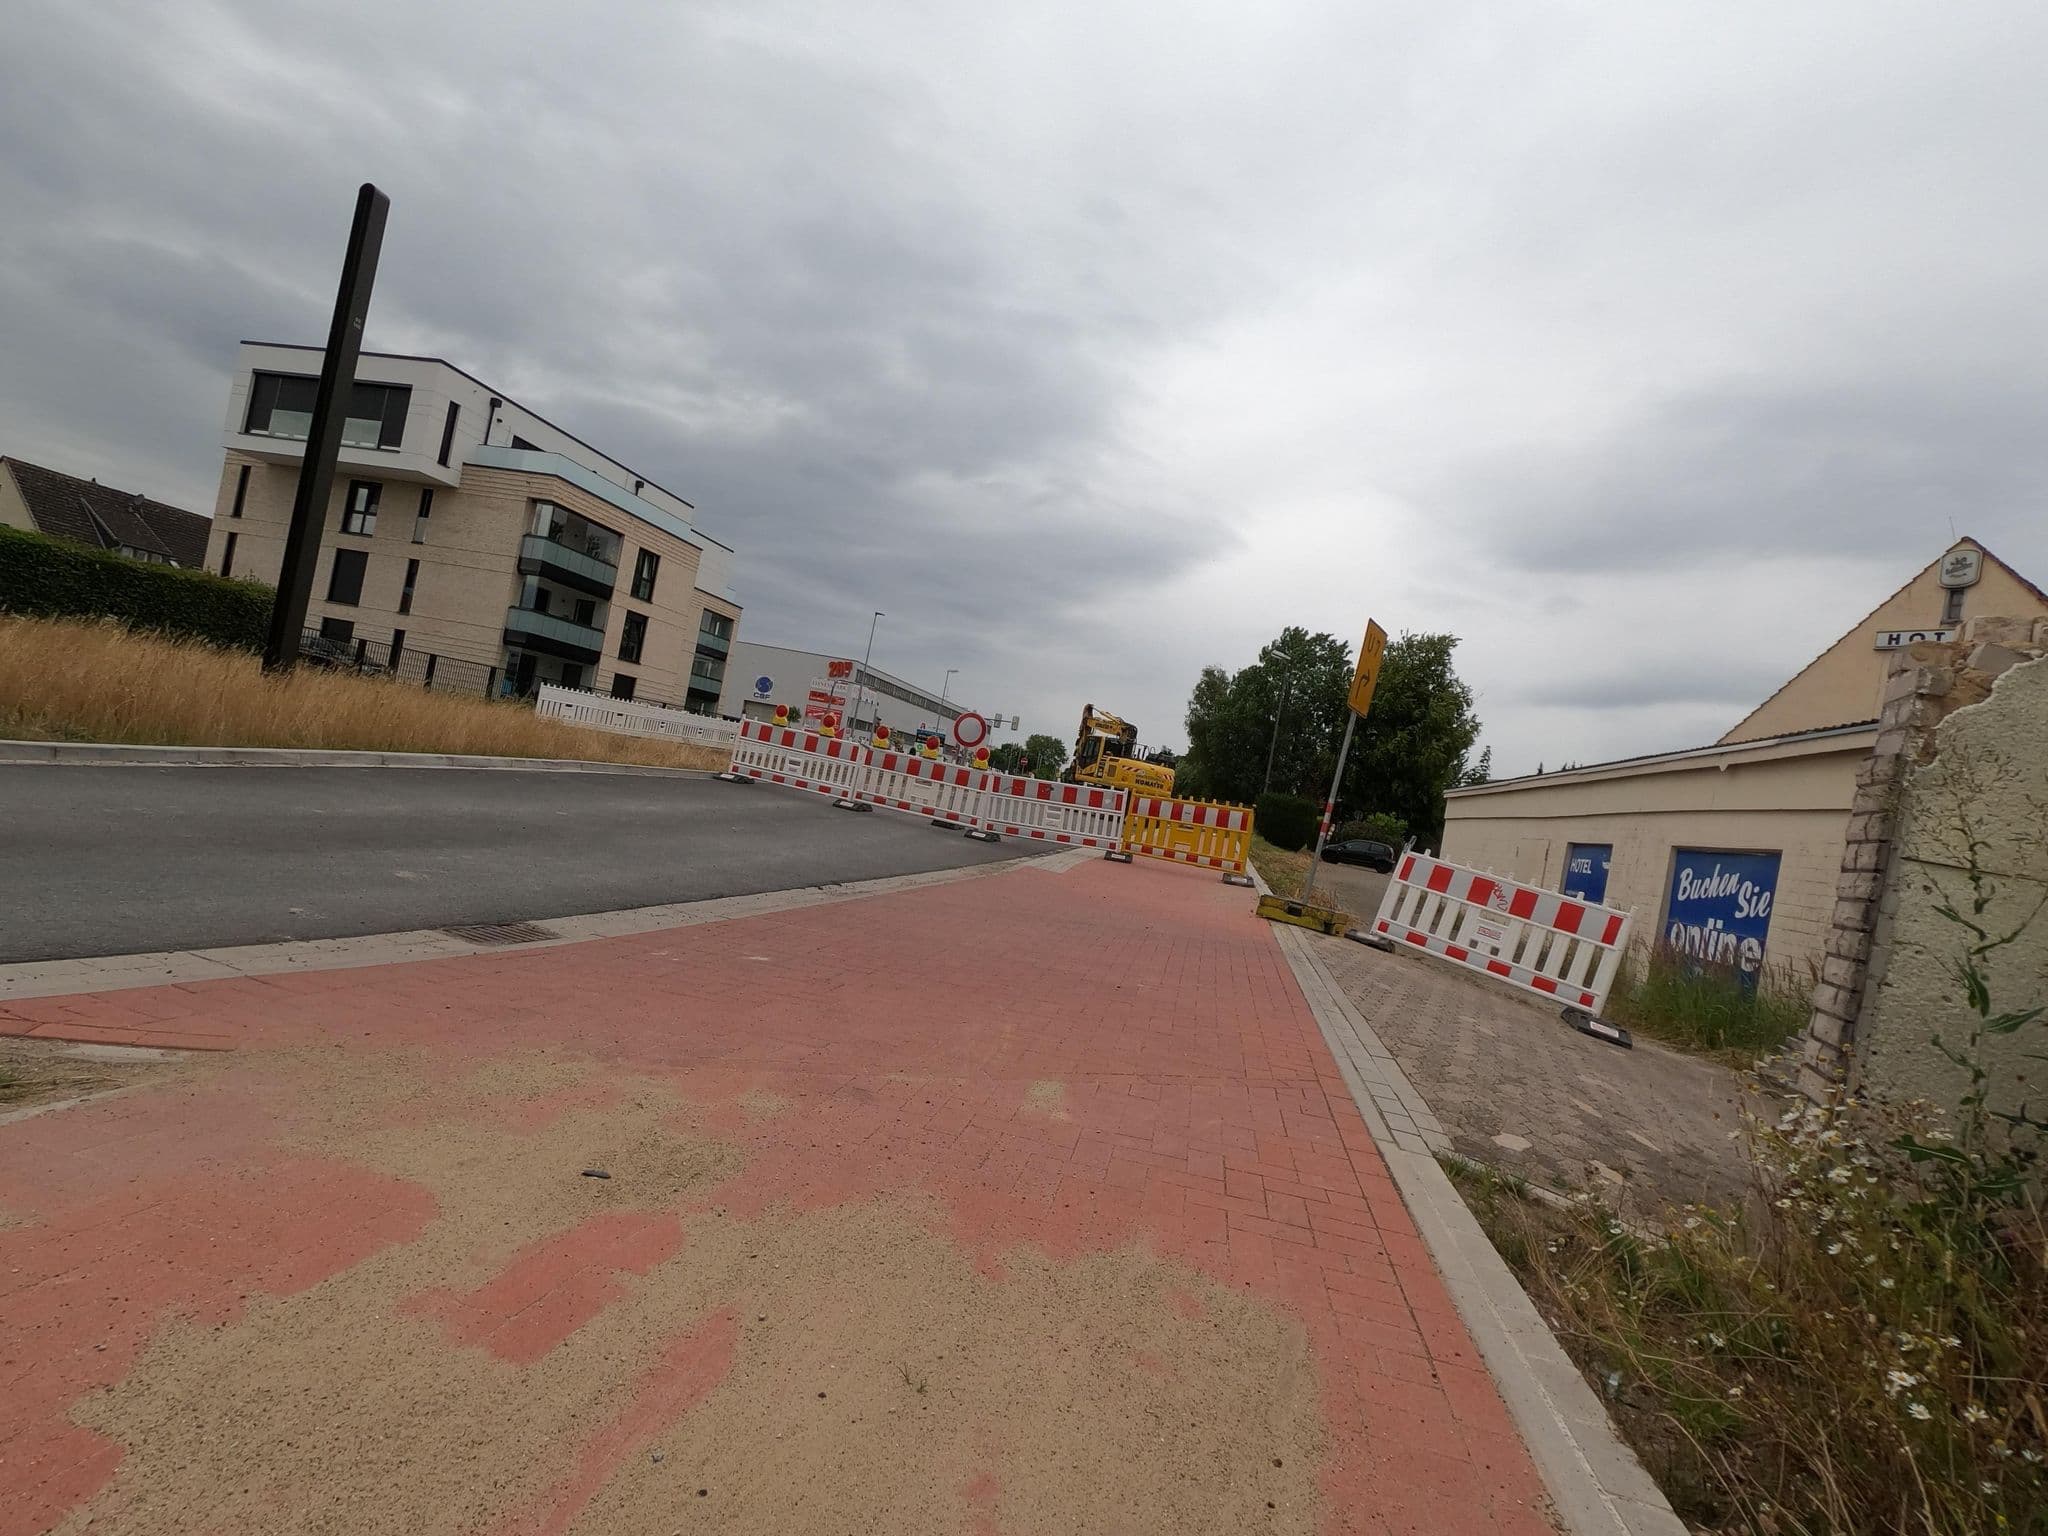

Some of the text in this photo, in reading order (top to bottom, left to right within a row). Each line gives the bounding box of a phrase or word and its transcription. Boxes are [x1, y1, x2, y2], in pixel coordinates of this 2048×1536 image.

[1569, 858, 1592, 874] HOTEL
[1677, 863, 1740, 901] Buchen
[1734, 880, 1771, 918] Sie
[1670, 917, 1762, 972] online
